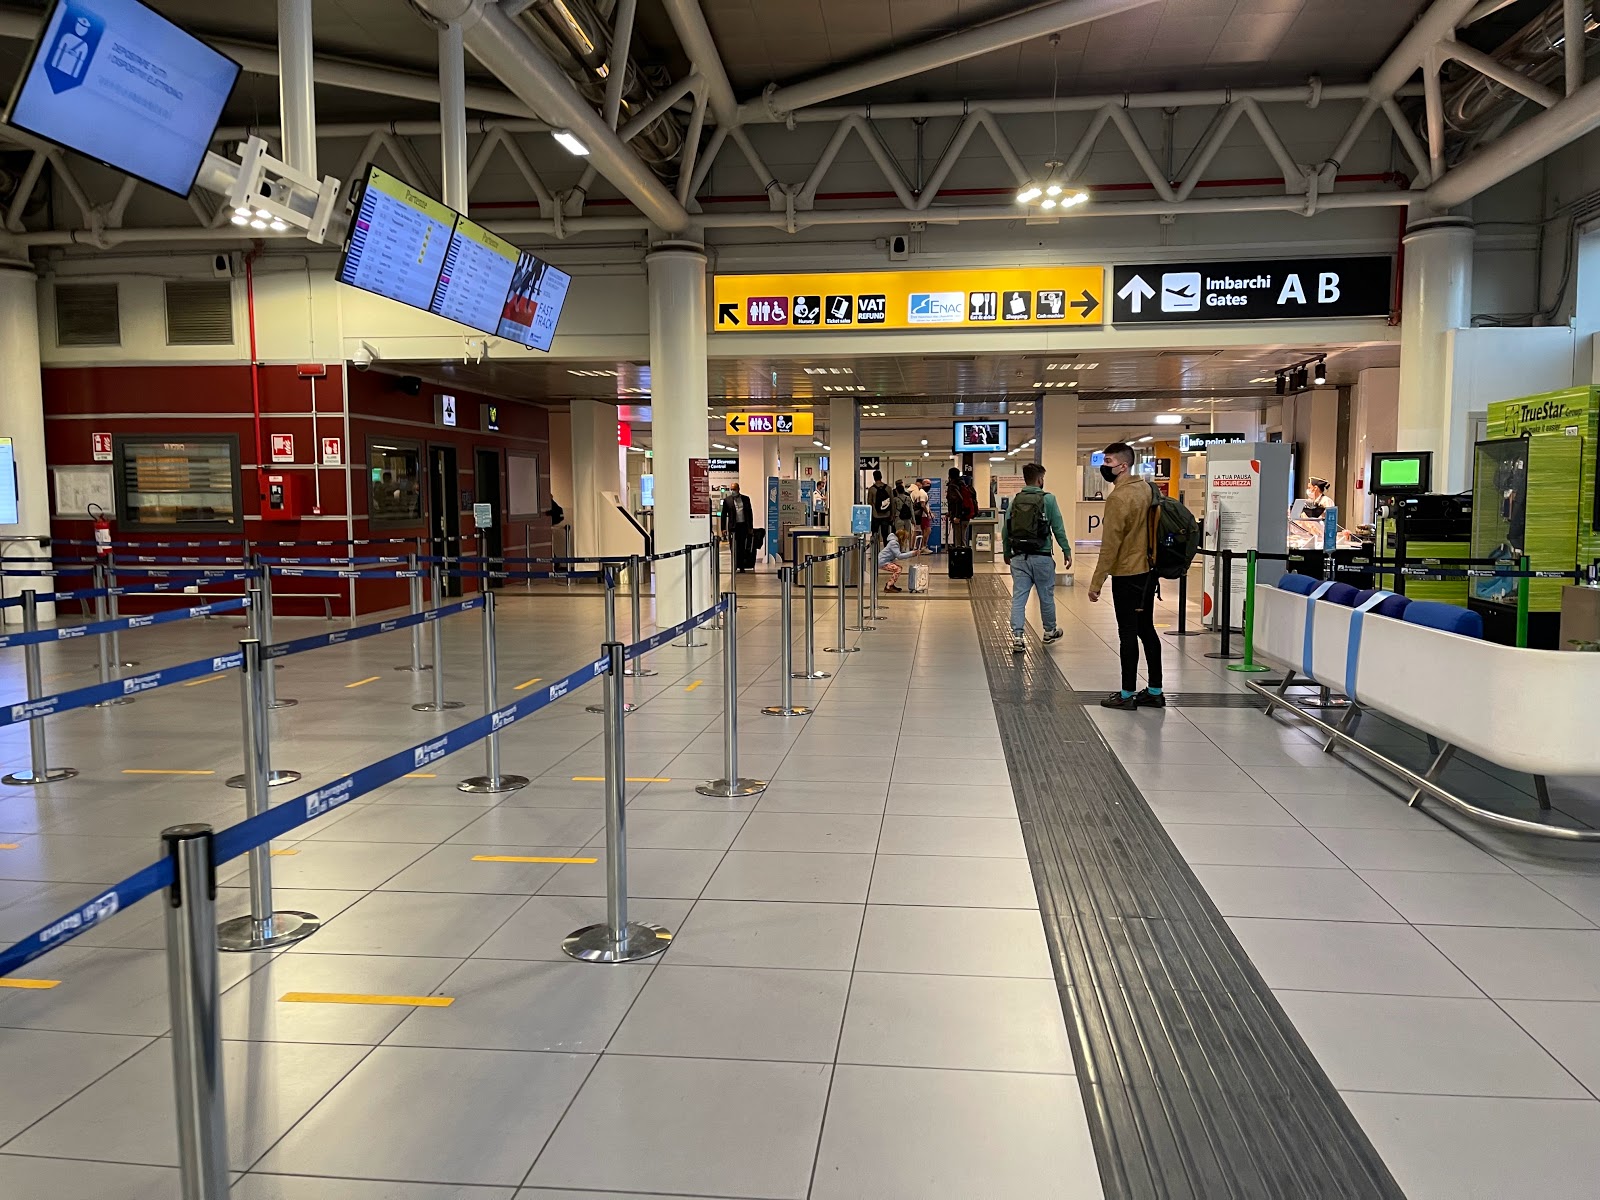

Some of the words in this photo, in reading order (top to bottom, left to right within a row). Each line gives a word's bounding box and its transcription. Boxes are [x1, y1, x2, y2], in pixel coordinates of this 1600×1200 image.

[1206, 275, 1271, 290] Imbarchi
[1276, 273, 1307, 305] A
[1317, 272, 1341, 304] B
[858, 299, 885, 311] VAT
[1206, 293, 1248, 307] Gates
[539, 302, 554, 317] FAST
[858, 312, 885, 320] REFUND
[536, 315, 554, 331] TRACK
[1521, 401, 1565, 423] TrueStar
[1190, 438, 1204, 447] Info
